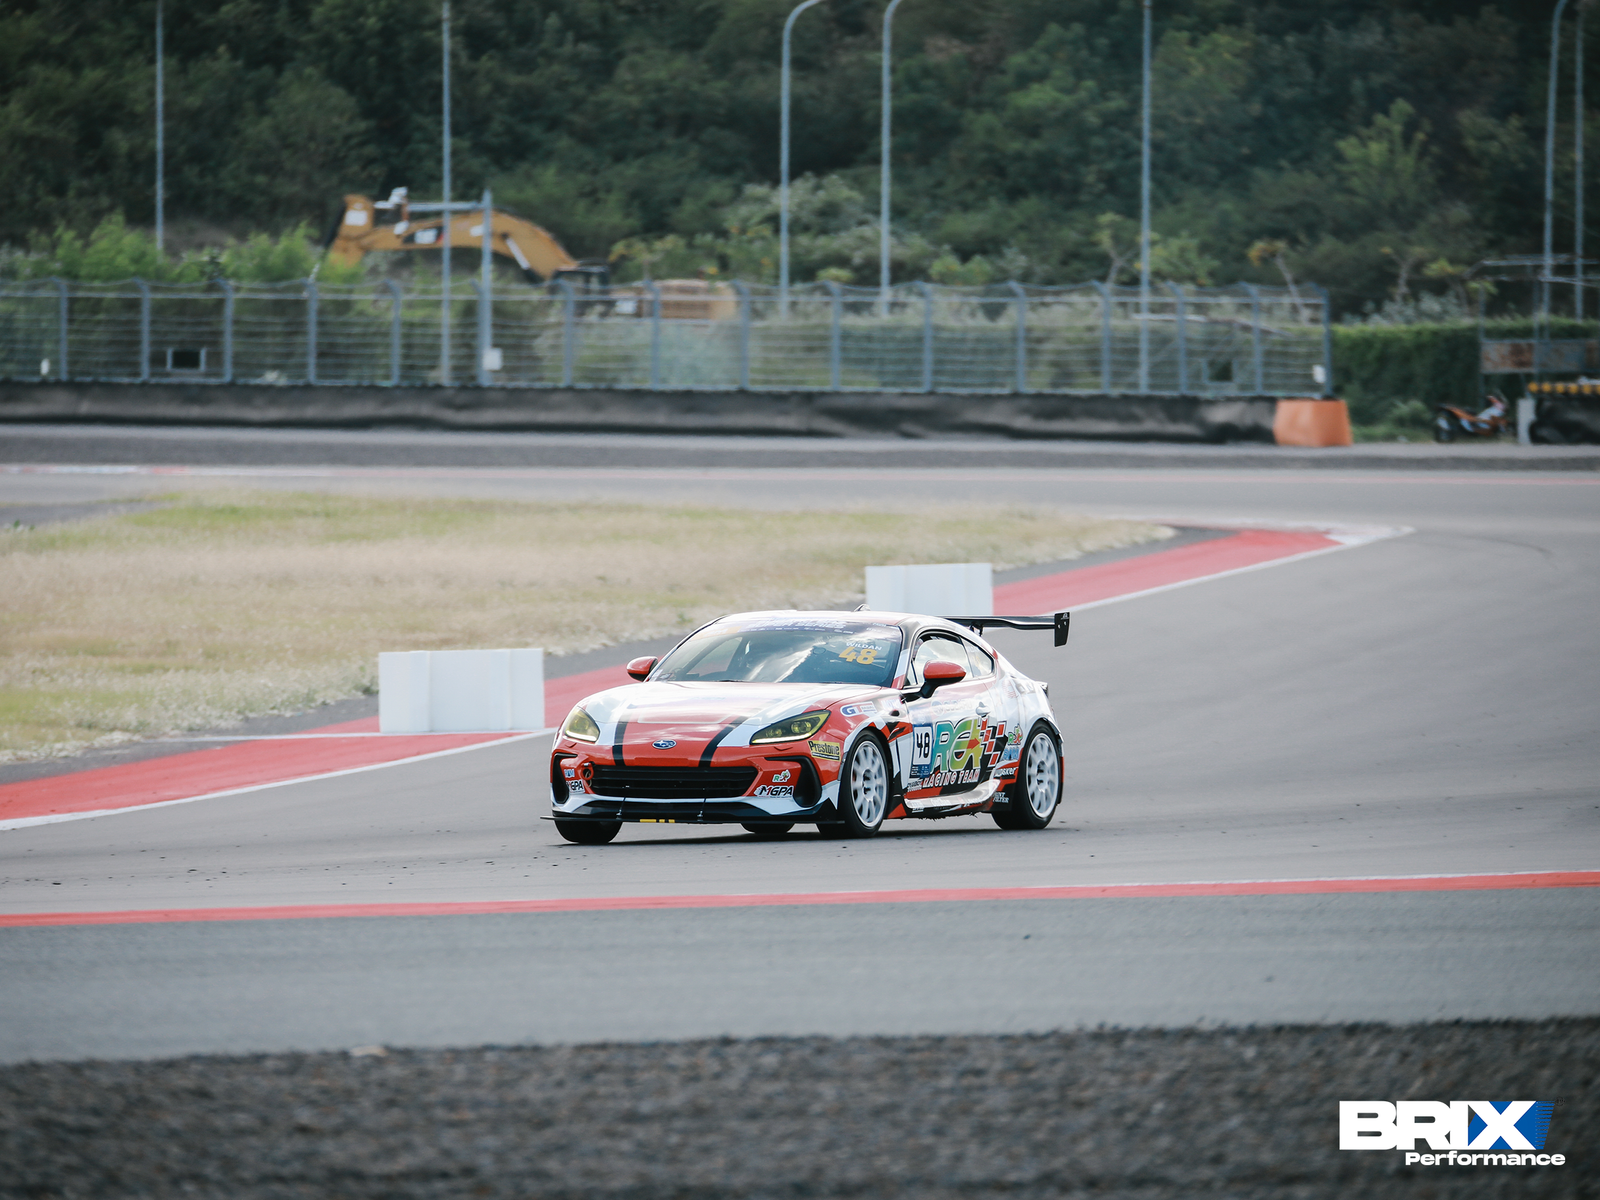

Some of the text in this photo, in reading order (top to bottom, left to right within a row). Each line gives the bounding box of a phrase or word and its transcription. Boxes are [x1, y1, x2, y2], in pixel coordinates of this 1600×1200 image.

[846, 641, 882, 651] WILDAN
[839, 647, 877, 664] 48
[809, 741, 840, 756] Prestone
[916, 732, 930, 758] 48
[923, 772, 957, 787] RACING
[958, 769, 980, 784] TEAM
[759, 786, 793, 796] MGPA
